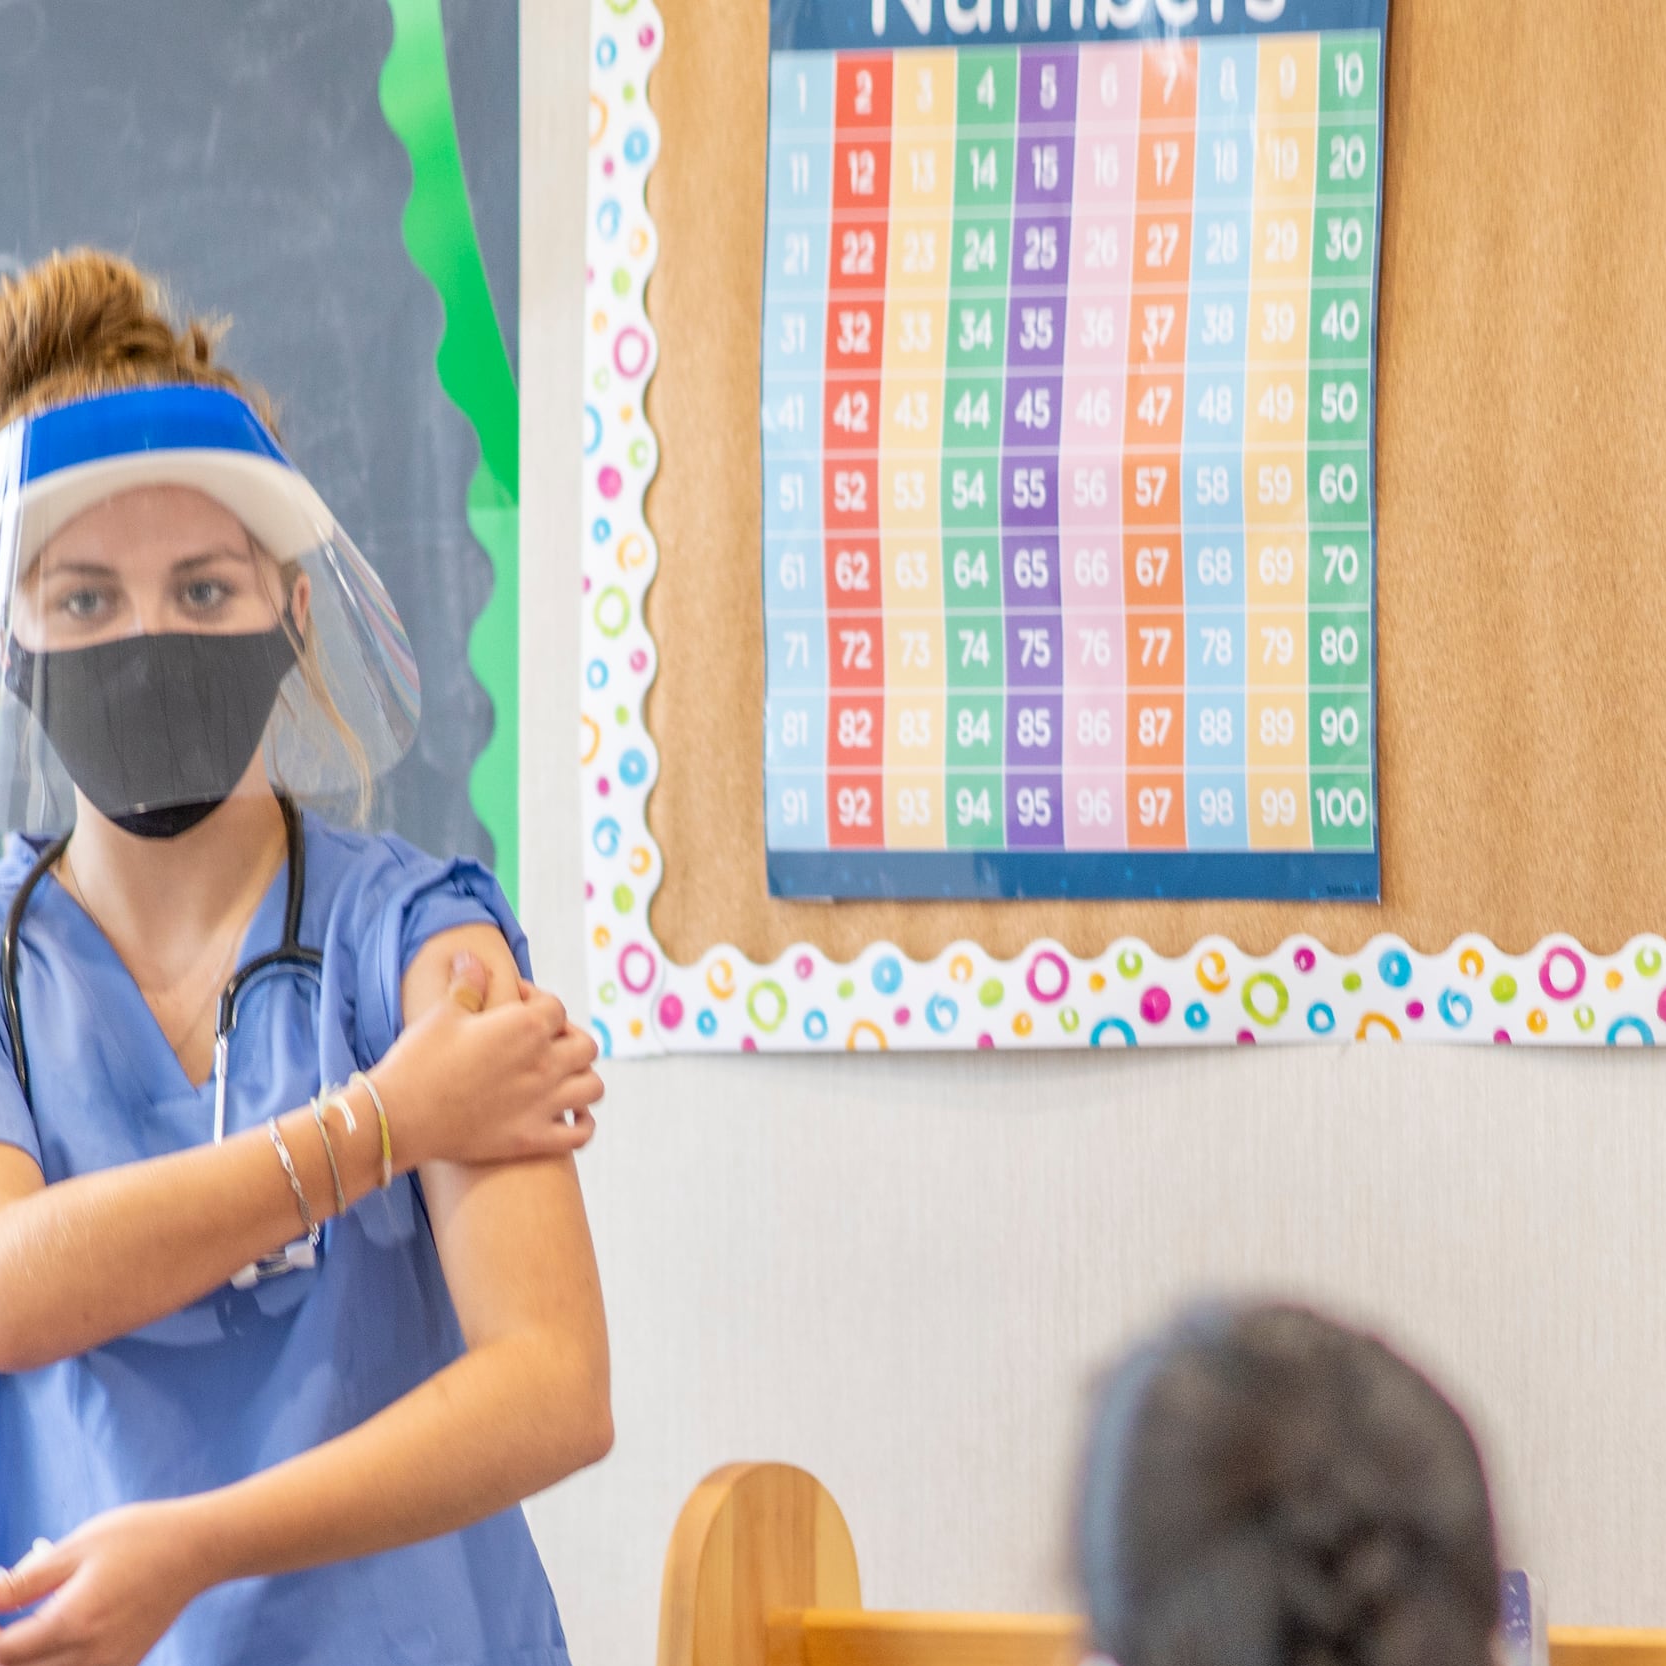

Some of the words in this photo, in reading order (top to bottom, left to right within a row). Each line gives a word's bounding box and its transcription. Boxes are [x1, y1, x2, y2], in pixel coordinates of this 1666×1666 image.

[855, 71, 873, 114] 2
[976, 67, 995, 109] 4
[1040, 65, 1057, 108] 5
[1161, 61, 1176, 104] 7
[1334, 53, 1364, 97] 10
[848, 150, 875, 194] 12
[970, 148, 998, 191] 14
[1033, 145, 1058, 190] 15
[1153, 142, 1179, 186] 17
[1330, 135, 1366, 179] 20
[841, 231, 875, 274] 22
[963, 229, 997, 272] 24
[1024, 227, 1058, 270] 25
[1146, 224, 1180, 267] 27
[1326, 219, 1362, 260] 30
[837, 311, 871, 353] 32
[959, 309, 993, 350] 34
[1019, 308, 1053, 350] 35
[1142, 305, 1175, 347] 37
[1202, 302, 1234, 343] 38
[1262, 302, 1295, 343] 39
[1321, 300, 1360, 341] 40
[834, 391, 869, 431] 42
[954, 390, 990, 428] 44
[1015, 388, 1050, 428] 45
[1138, 385, 1172, 425] 47
[1197, 385, 1232, 424] 48
[1258, 384, 1294, 422] 49
[1321, 382, 1357, 422] 50
[834, 471, 867, 511] 52
[952, 469, 986, 509] 54
[1012, 469, 1046, 509] 55
[1135, 466, 1168, 507] 57
[1196, 465, 1229, 505] 58
[1257, 465, 1291, 505] 59
[1319, 464, 1357, 504] 60
[835, 551, 869, 591] 62
[953, 550, 989, 589] 64
[1013, 549, 1049, 588] 65
[1135, 547, 1169, 586] 67
[1197, 547, 1232, 585] 68
[1258, 546, 1293, 584] 69
[1322, 546, 1358, 584] 70
[840, 631, 872, 669] 72
[959, 630, 990, 668] 74
[1018, 630, 1050, 667] 75
[1139, 628, 1171, 666] 77
[1200, 628, 1232, 665] 78
[1261, 627, 1294, 664] 79
[1320, 627, 1357, 664] 80
[838, 709, 872, 748] 82
[957, 709, 991, 747] 84
[1016, 708, 1051, 747] 85
[1138, 708, 1172, 746] 87
[1259, 707, 1295, 745] 89
[1320, 707, 1358, 746] 90
[837, 788, 872, 827] 92
[957, 788, 991, 827] 94
[1016, 787, 1050, 826] 95
[1138, 787, 1173, 826] 97
[1260, 787, 1296, 826] 99
[1315, 787, 1366, 826] 100
